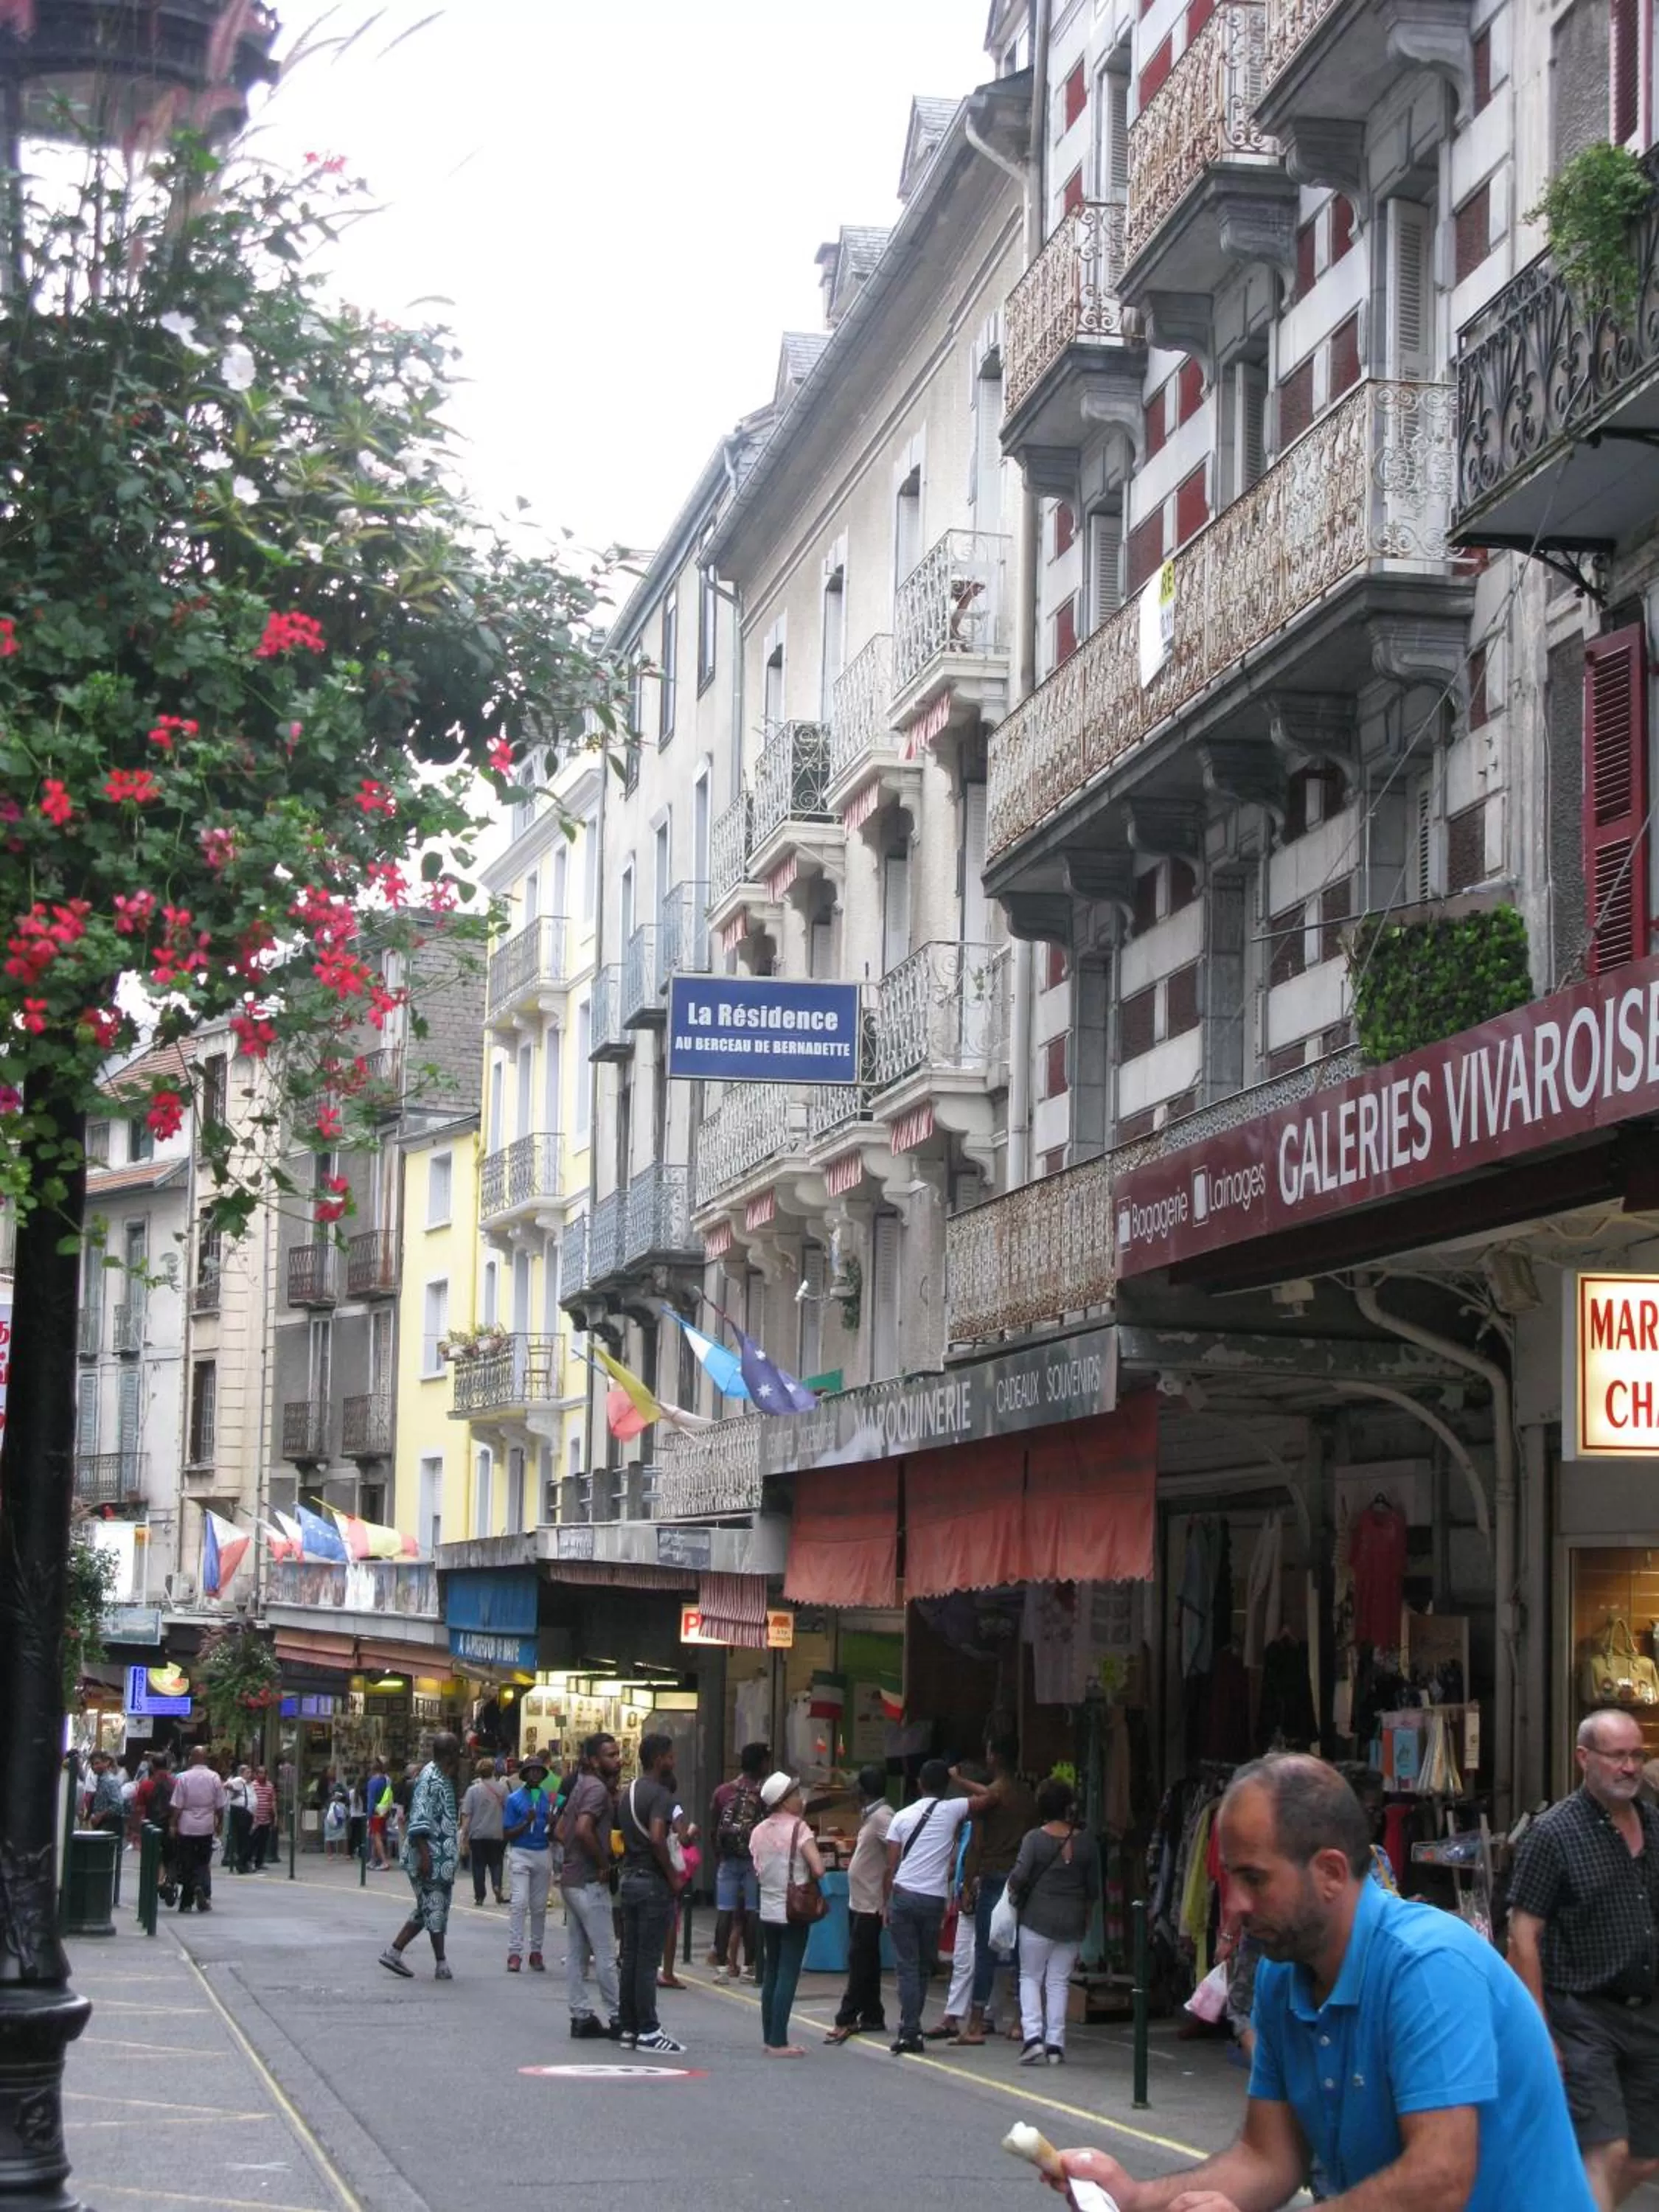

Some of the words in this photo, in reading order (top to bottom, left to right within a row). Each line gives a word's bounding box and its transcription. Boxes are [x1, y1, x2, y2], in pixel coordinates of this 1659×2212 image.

[688, 1002, 712, 1026] La
[717, 1004, 838, 1031] Résidence
[675, 1036, 692, 1051] AU
[695, 1037, 751, 1053] BERCEAU
[754, 1040, 769, 1054] DE
[773, 1041, 850, 1057] BERNADETTE
[1279, 1070, 1433, 1206] GALERIES
[1209, 1162, 1267, 1211] Lainages
[1132, 1186, 1189, 1244] Bagagerie
[996, 1369, 1039, 1413] CADEAUX
[1046, 1354, 1101, 1402] SOUVENIRS
[1605, 1380, 1659, 1429] CH
